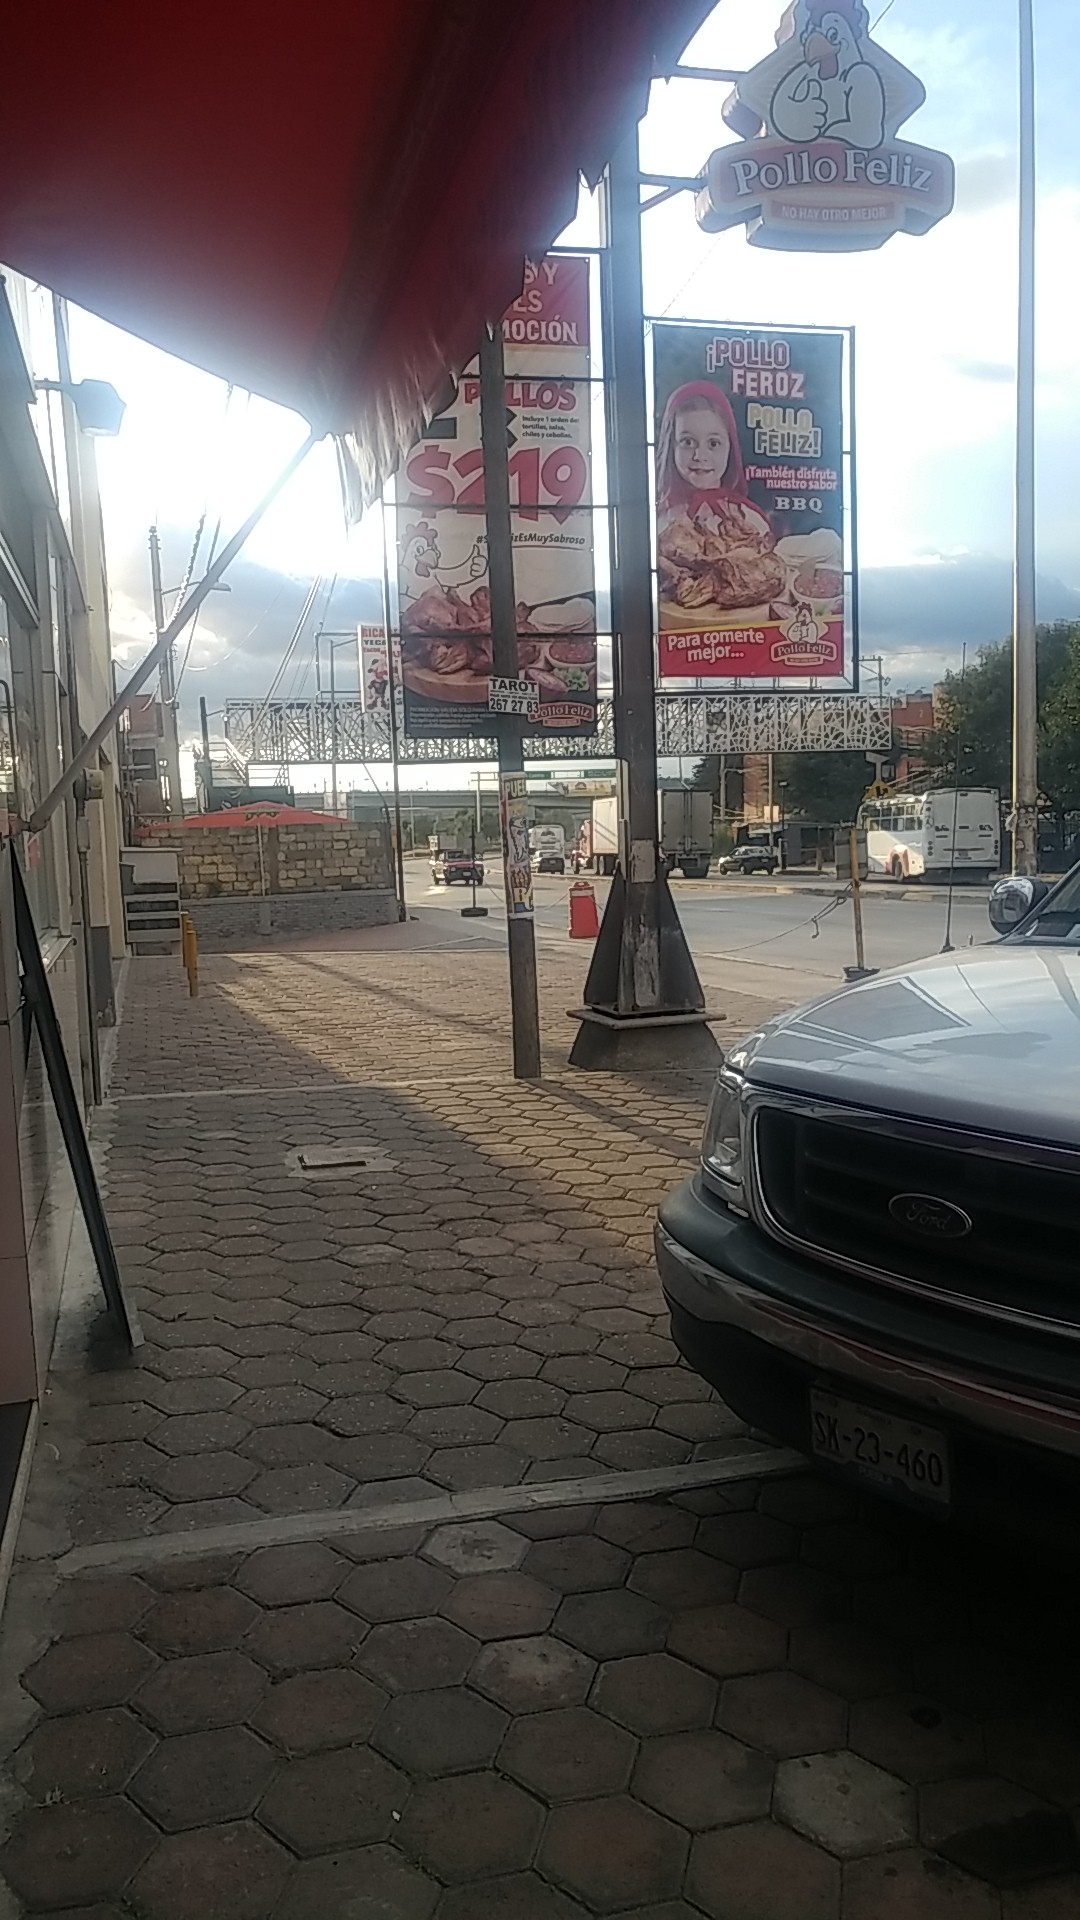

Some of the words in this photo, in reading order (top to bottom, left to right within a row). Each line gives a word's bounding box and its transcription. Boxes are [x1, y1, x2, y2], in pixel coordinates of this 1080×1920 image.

[730, 150, 838, 196] Pollo
[843, 150, 934, 192] Feliz
[782, 205, 798, 218] NO
[800, 206, 820, 220] HAY
[822, 207, 849, 221] OTRO
[851, 205, 887, 220] MEJOR
[542, 262, 560, 286] Y
[706, 337, 790, 373] ¡POLLO
[732, 369, 805, 398] FEROZ
[464, 381, 577, 411] PLLOS
[747, 402, 813, 431] POLLO
[755, 427, 822, 458] FELIZ!
[406, 444, 588, 525] $219
[745, 465, 795, 481] ¡También
[796, 466, 837, 480] disfruta
[766, 478, 807, 490] nuestro
[808, 478, 838, 491] sabor
[774, 496, 823, 513] BBQ
[667, 631, 700, 651] Para
[703, 628, 765, 645] comerte
[777, 644, 805, 657] Pollo
[806, 643, 831, 655] Feliz
[687, 645, 745, 664] mejor...
[489, 678, 538, 693] TAROT
[490, 697, 508, 711] 267
[511, 699, 523, 712] 27
[527, 700, 540, 713] 83
[906, 1201, 952, 1230] Ford
[814, 1411, 943, 1487] SK-23-460
